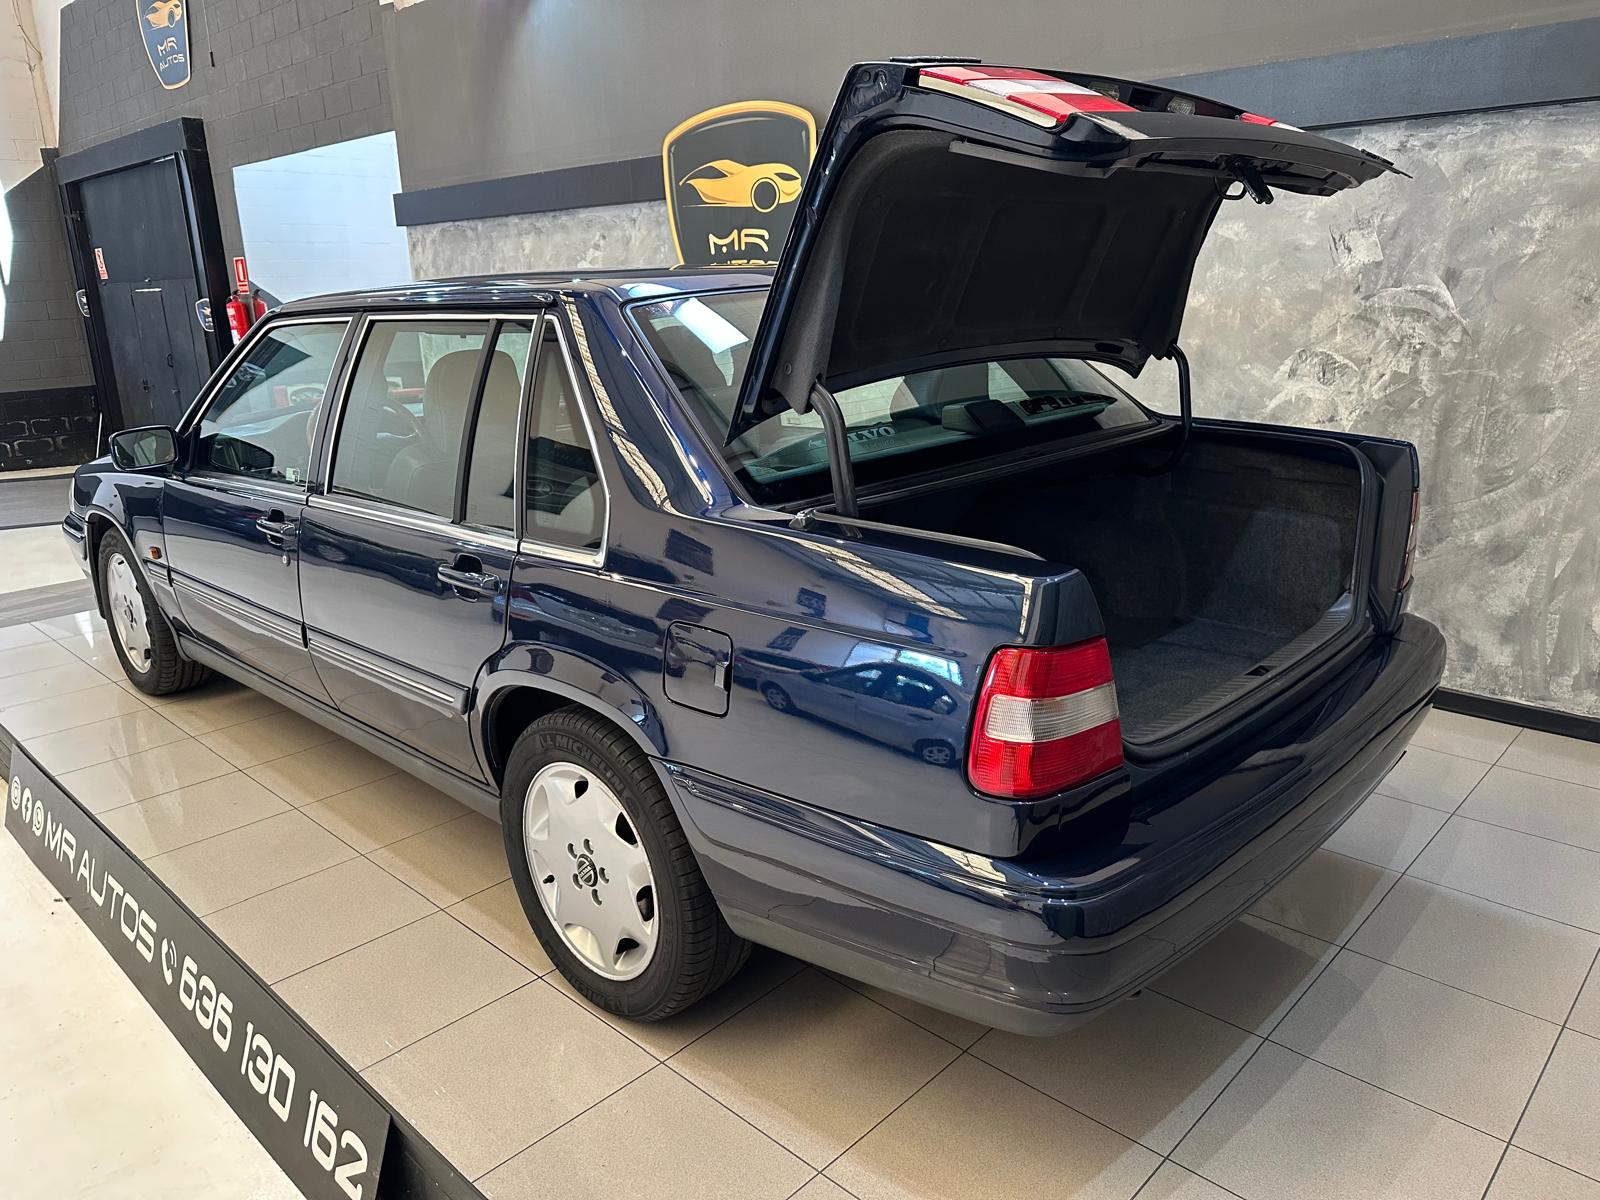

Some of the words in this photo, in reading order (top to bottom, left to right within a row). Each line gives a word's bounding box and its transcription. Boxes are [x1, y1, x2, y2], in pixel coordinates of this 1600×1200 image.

[157, 37, 178, 57] MR
[159, 54, 185, 72] AUTOS
[708, 228, 770, 256] MR
[44, 811, 77, 874] MR
[76, 849, 157, 963] AUTOS
[179, 955, 234, 1052] 636
[240, 1021, 296, 1122] 130
[303, 1089, 368, 1200] 162
